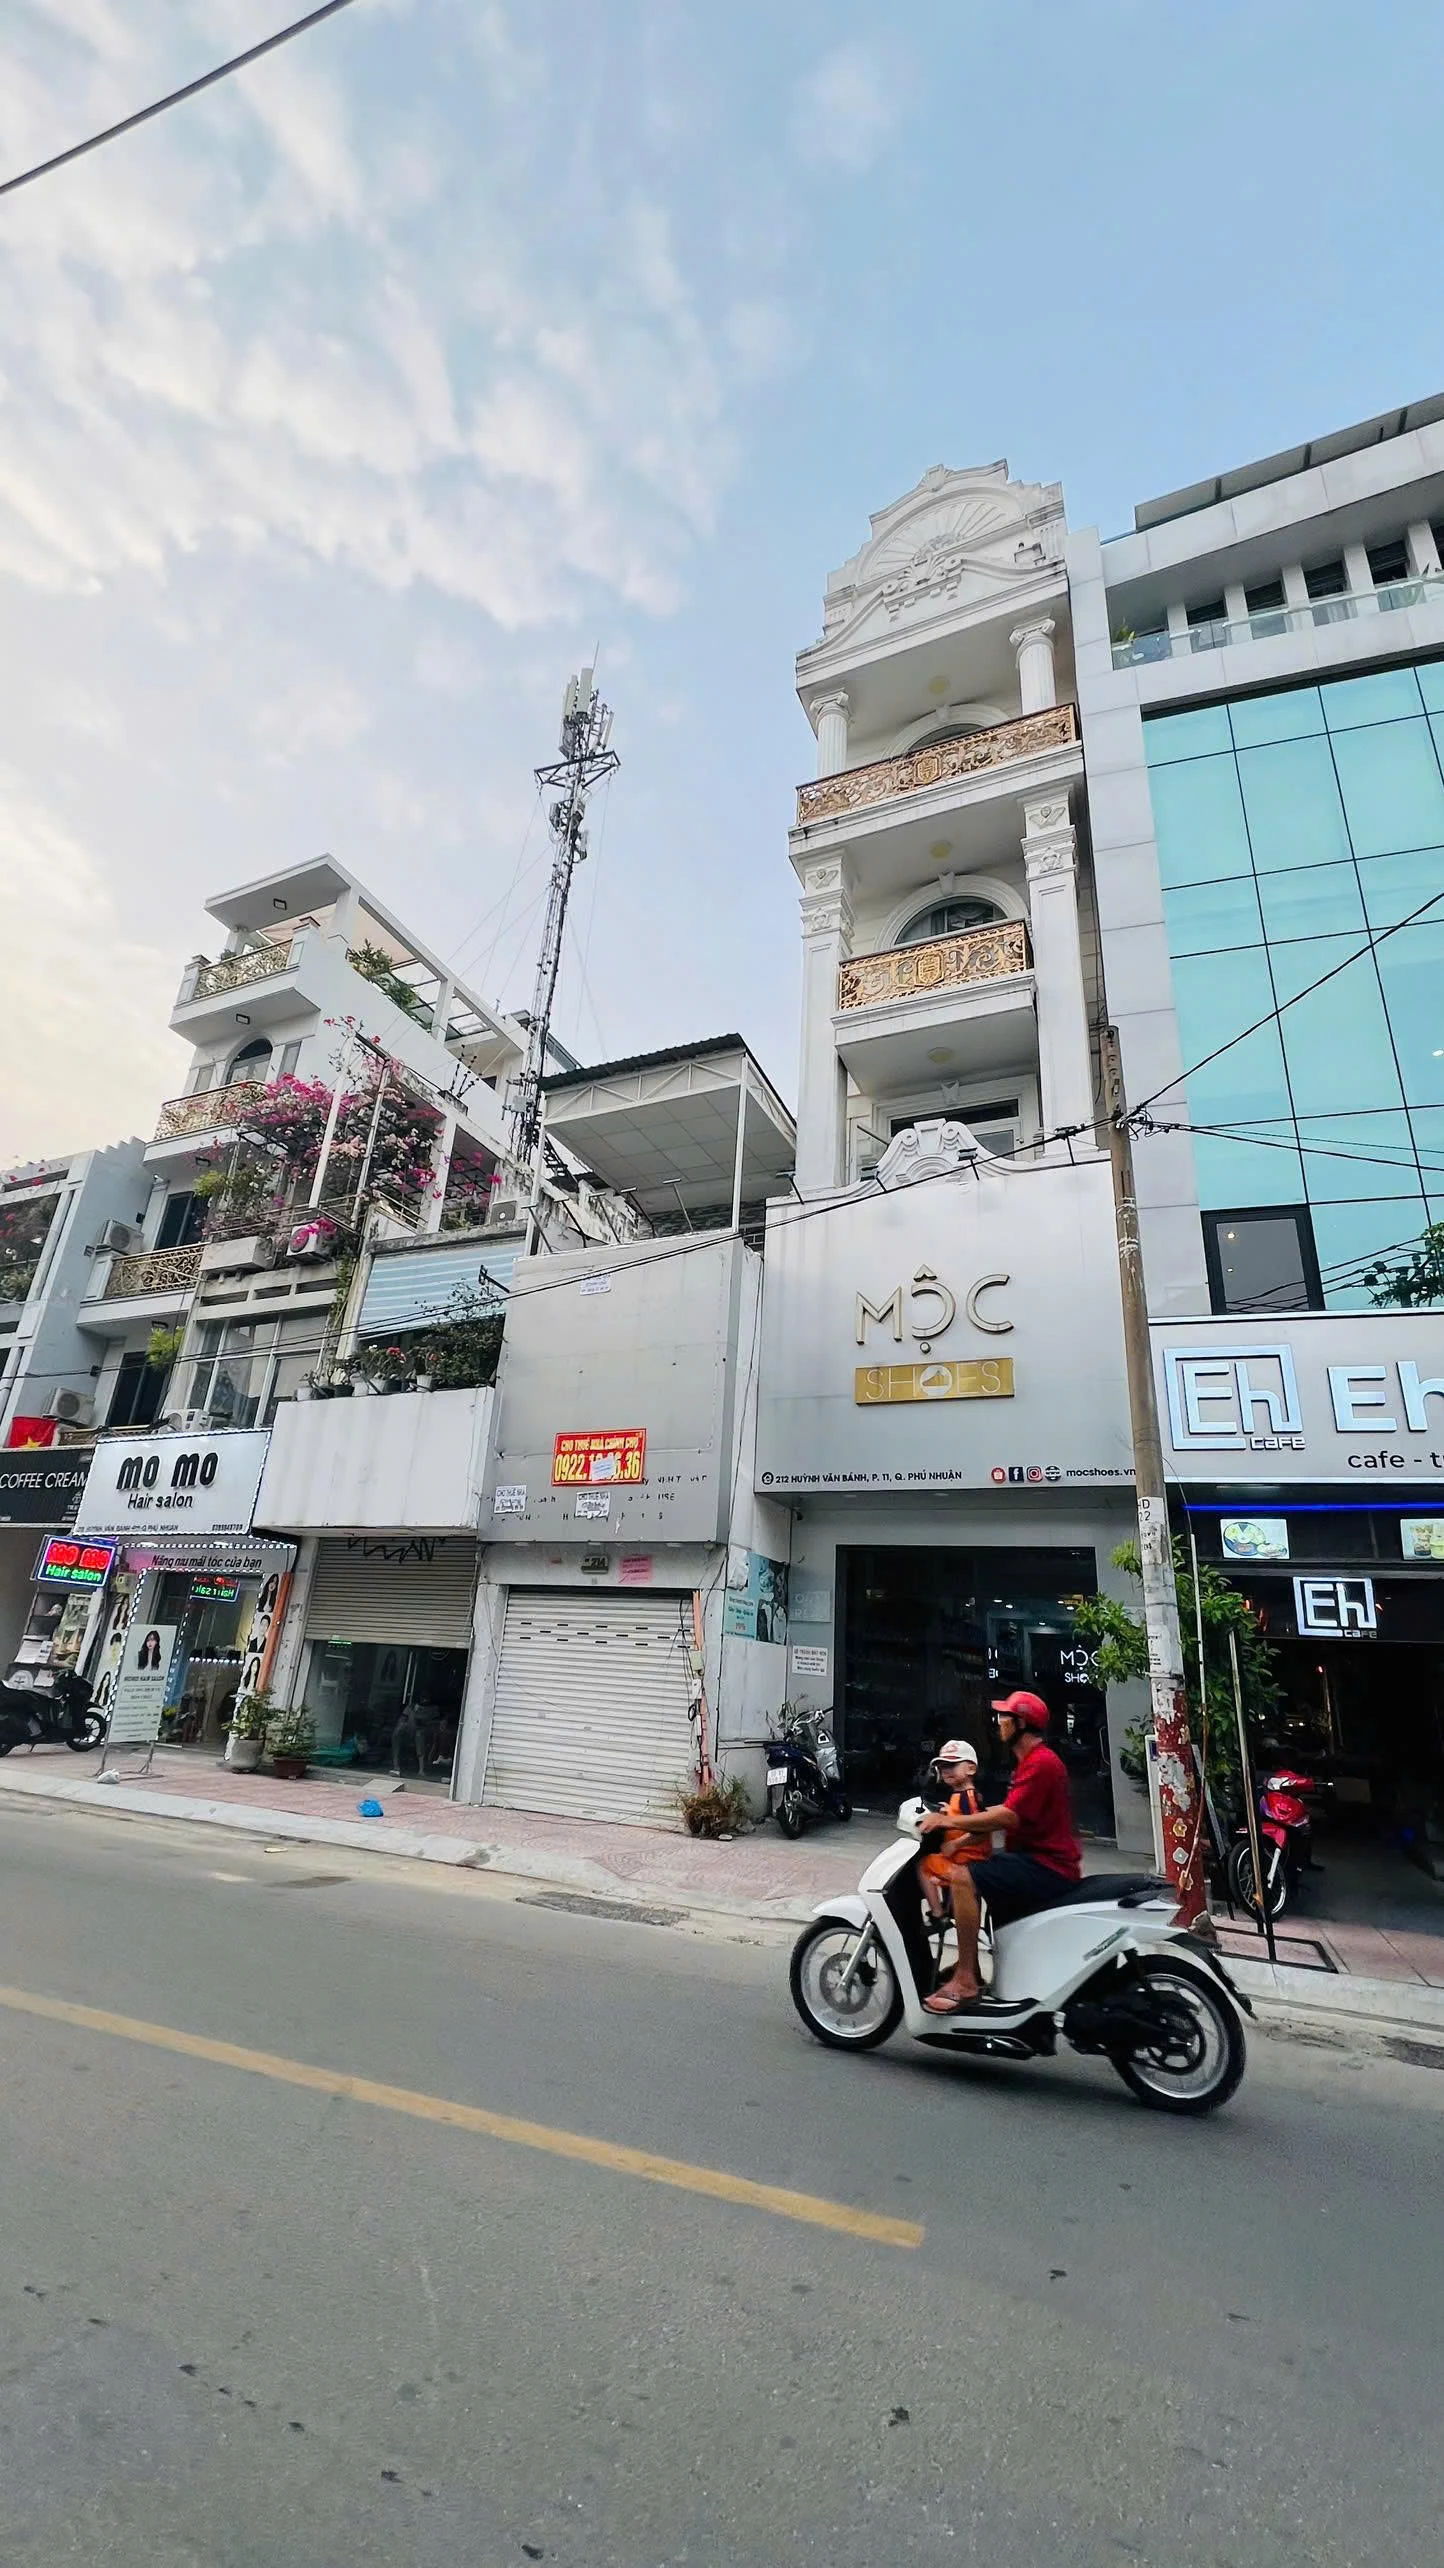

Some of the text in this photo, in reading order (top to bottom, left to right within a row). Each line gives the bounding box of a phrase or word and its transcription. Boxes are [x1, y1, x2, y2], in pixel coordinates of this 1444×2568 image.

[855, 1264, 1014, 1354] MỘC
[1347, 1451, 1405, 1469] cafe
[0, 1473, 44, 1489] COFFEE
[776, 1475, 789, 1483] 212
[791, 1473, 820, 1483] HUỲNH
[822, 1473, 840, 1483] VĂN
[871, 1473, 880, 1482] P.
[908, 1469, 927, 1480] PHÚ
[929, 1469, 962, 1482] NHUẬN
[128, 1491, 193, 1508] Hair salon
[46, 1564, 70, 1579] Hair
